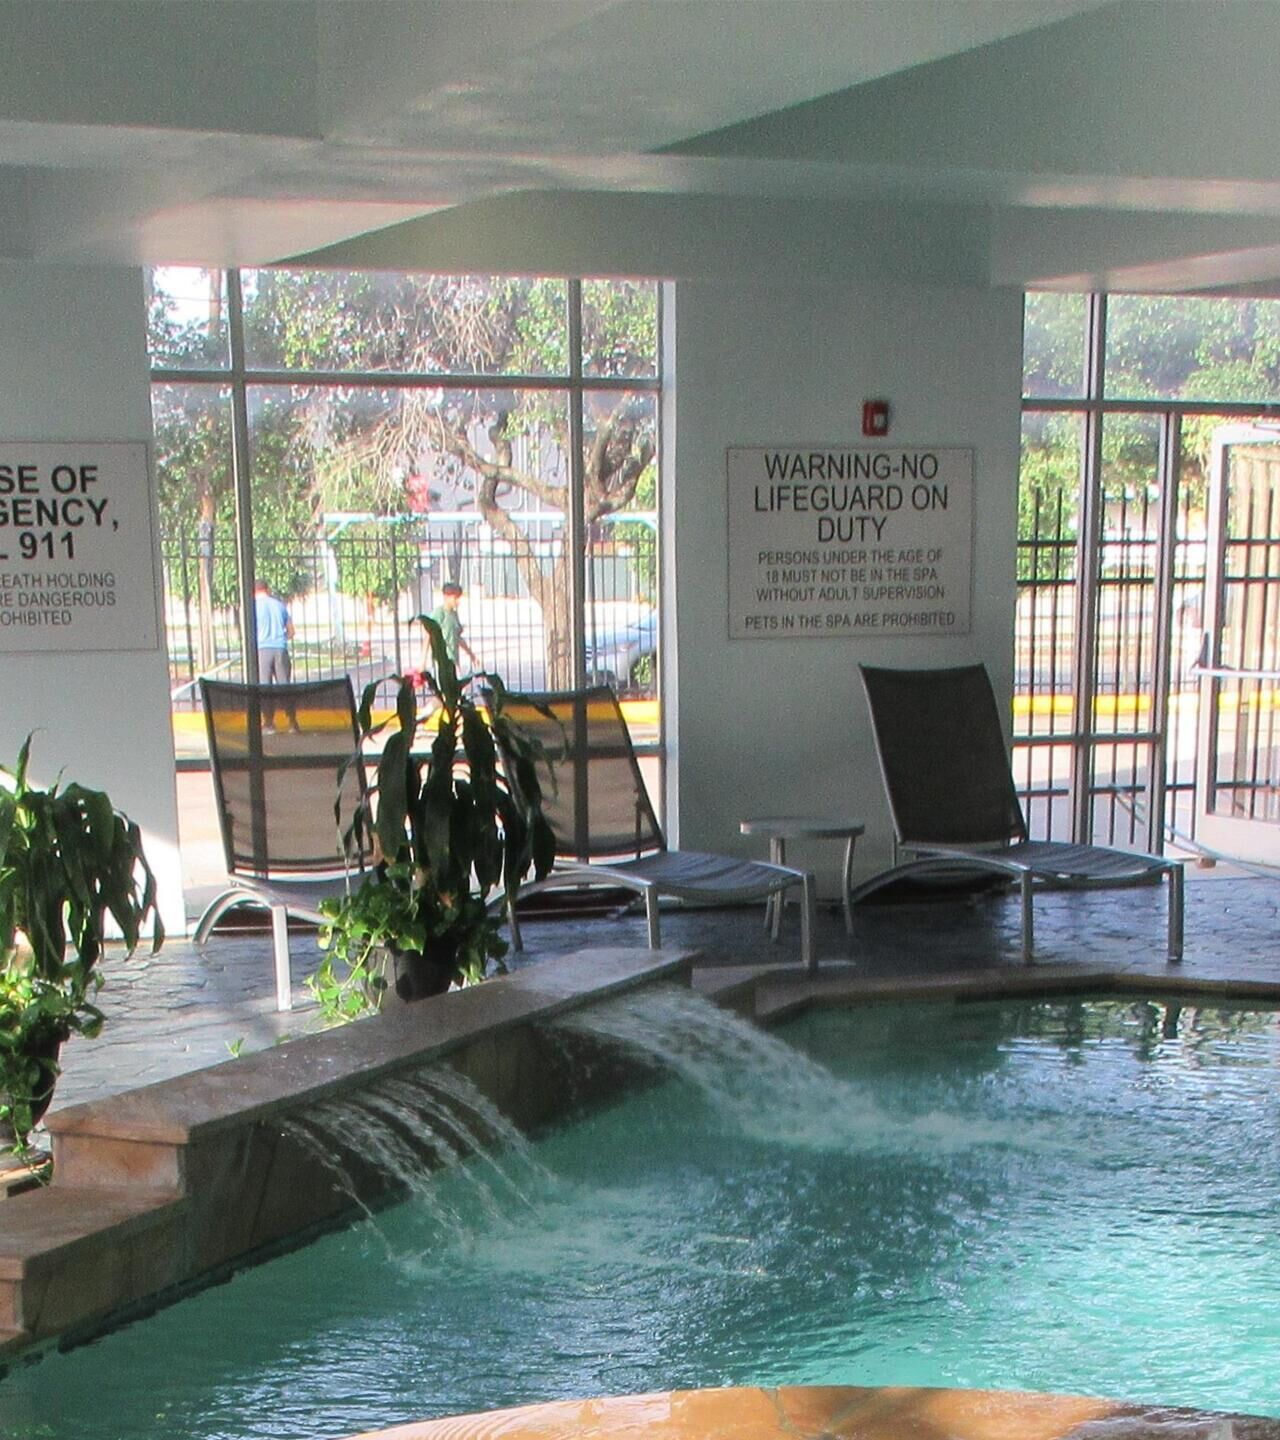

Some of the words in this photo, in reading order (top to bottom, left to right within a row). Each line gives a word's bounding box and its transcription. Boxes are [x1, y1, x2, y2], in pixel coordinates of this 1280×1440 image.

[764, 453, 939, 480] WARNING-NO
[51, 465, 98, 494] OF
[754, 485, 903, 512] LIFEGUARD
[911, 485, 948, 511] ON
[818, 516, 887, 543] DUTY
[19, 531, 76, 559] 911
[757, 551, 820, 565] PERSONS
[823, 550, 867, 565] UNDER
[871, 550, 895, 564] THE
[897, 549, 923, 564] AGE
[926, 549, 943, 562] OF
[47, 573, 115, 588] HOLDING
[765, 569, 779, 583] 18
[782, 569, 817, 583] MUST
[821, 569, 847, 583] NOT
[850, 568, 867, 582] BE
[870, 568, 883, 582] IN
[886, 568, 910, 582] THE
[913, 568, 938, 581] SPA
[19, 592, 116, 607] DANGEROUS
[756, 587, 816, 602] WITHOUT
[819, 586, 858, 601] ADULT
[862, 585, 945, 600] SUPERVISION
[745, 616, 778, 630] PETS
[781, 615, 794, 629] IN
[798, 615, 822, 629] THE
[826, 614, 851, 628] SPA
[853, 613, 879, 627] ARE
[882, 612, 955, 627] PROHIBITED
